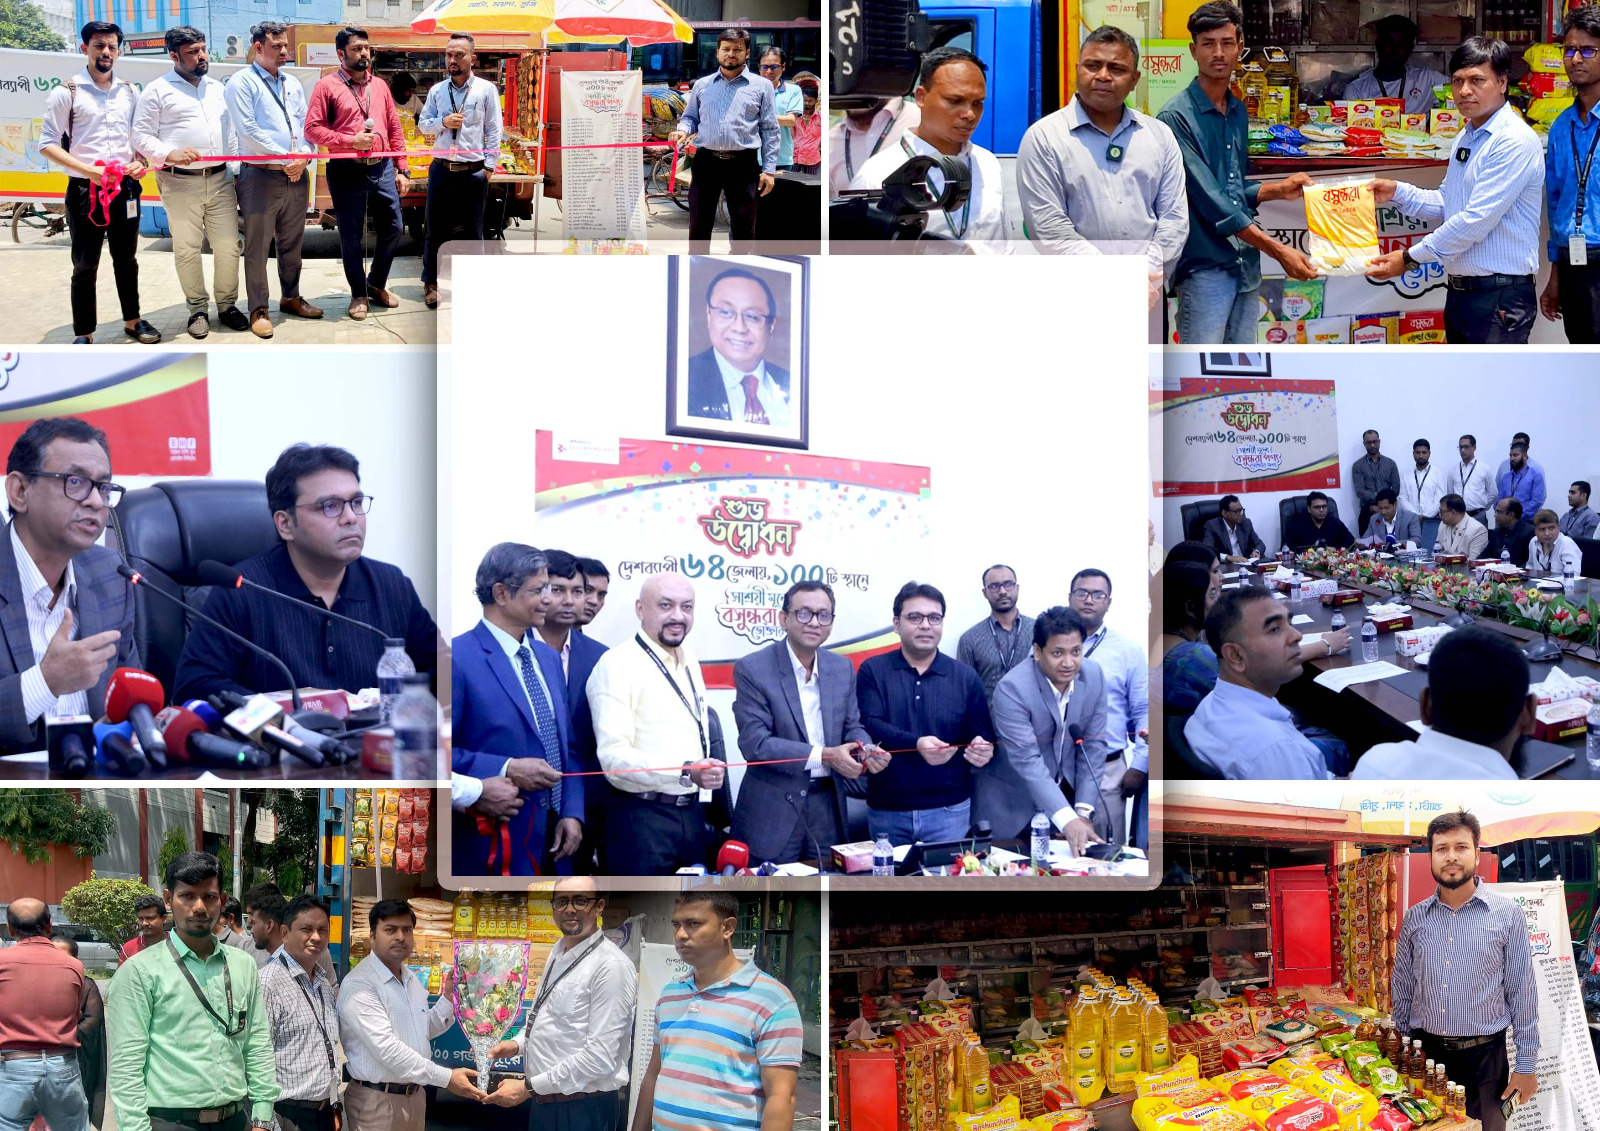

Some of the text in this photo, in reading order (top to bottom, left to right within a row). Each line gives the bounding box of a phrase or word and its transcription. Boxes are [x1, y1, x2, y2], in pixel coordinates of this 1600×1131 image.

[1141, 55, 1181, 77] বসুন্ধরা
[1323, 186, 1360, 206] বসুন্ধরা
[1222, 410, 1270, 429] উদ্বোধন
[1231, 403, 1254, 414] শুভ
[1214, 430, 1236, 443] ৬৪
[723, 499, 767, 521] শুভ
[701, 508, 800, 556] উদ্বোধন
[618, 556, 678, 580] দেশব্যাপী
[680, 553, 725, 580] ৬৪
[840, 573, 870, 591] স্থানে
[729, 585, 765, 607] সাশ্রয়ী
[720, 607, 778, 632] বসুন্ধরা
[1151, 1075, 1194, 1092] Bashundhara
